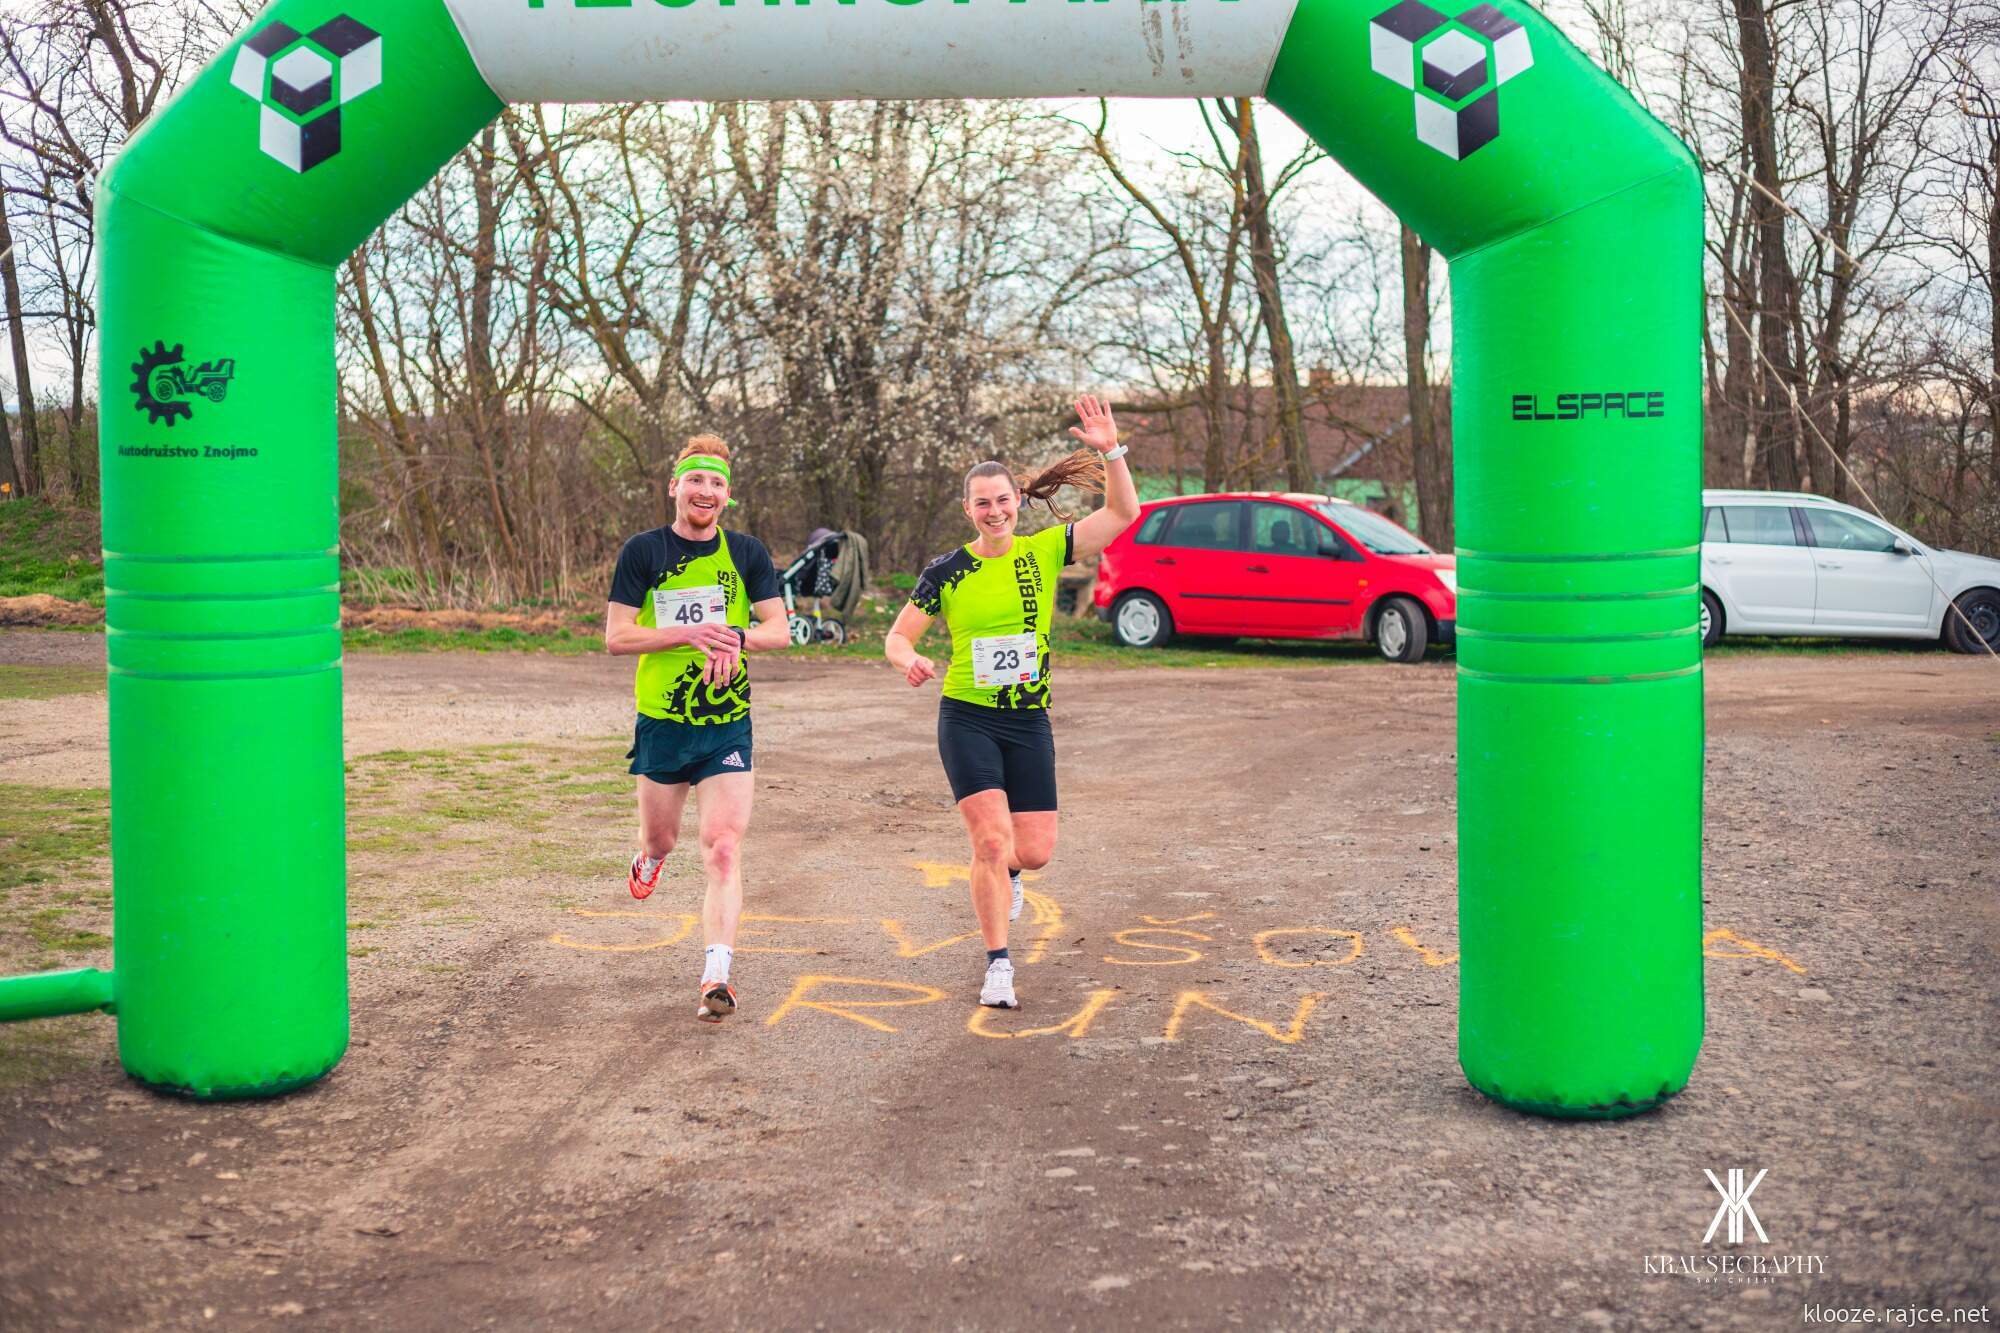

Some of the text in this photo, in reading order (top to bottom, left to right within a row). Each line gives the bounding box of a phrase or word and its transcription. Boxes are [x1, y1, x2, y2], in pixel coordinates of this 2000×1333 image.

[1512, 392, 1665, 420] ELSPACE
[118, 444, 258, 460] Autodružstvo Znojmo
[1026, 551, 1043, 593] ZNOJMO
[675, 602, 704, 625] 46
[993, 649, 1020, 671] 23
[766, 974, 1326, 1044] RUN
